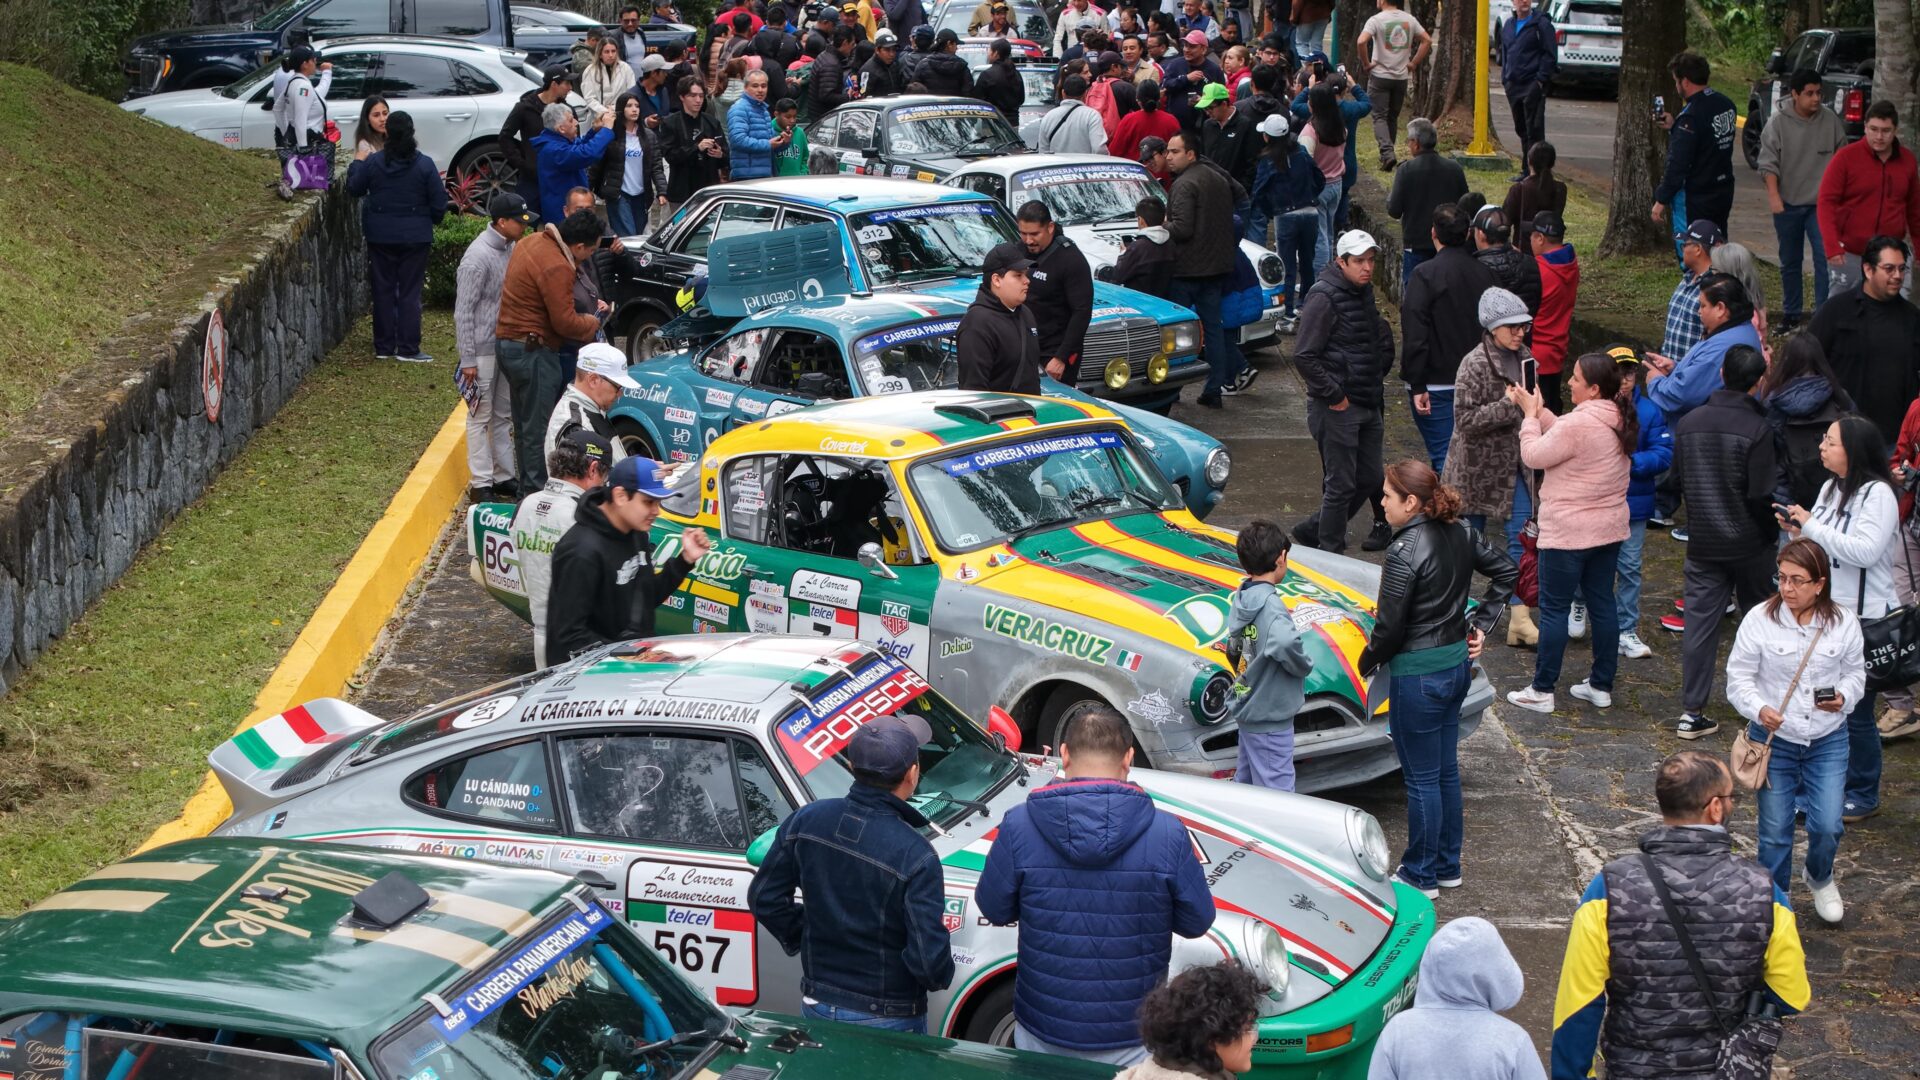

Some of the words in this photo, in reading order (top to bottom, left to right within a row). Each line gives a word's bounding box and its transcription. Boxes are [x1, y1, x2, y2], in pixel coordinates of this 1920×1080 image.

[1022, 174, 1085, 188] FARBEN
[1088, 171, 1149, 182] MOTORS
[892, 208, 927, 219] CARRERA
[927, 205, 980, 215] PANAMERICANA
[863, 228, 885, 240] 312
[883, 328, 925, 343] CARRERA
[878, 380, 904, 393] 299
[666, 408, 694, 420] PUEBLA
[974, 450, 1025, 467] CARRERA
[1025, 436, 1099, 457] PANAMERICANA
[819, 576, 849, 592] Carrera
[750, 599, 783, 614] VERACRUZ
[810, 605, 836, 620] telcel
[884, 602, 908, 618] TAG
[881, 615, 909, 638] HEUER
[984, 603, 1114, 665] VERACRUZ
[940, 637, 973, 658] Delicia
[1870, 643, 1896, 657] THE
[1865, 656, 1889, 669] OTE
[520, 705, 536, 723] LA
[540, 700, 602, 721] CARRERA
[789, 713, 812, 736] telcel
[811, 687, 851, 718] CARRERA
[802, 670, 929, 761] PORSCHE
[465, 779, 479, 792] LU
[480, 778, 530, 797] CÁNDANO
[463, 794, 473, 804] D.
[475, 795, 526, 811] CANDANO
[416, 841, 477, 859] MÉXICO
[485, 841, 545, 861] CHIAPAS
[1226, 850, 1246, 862] TO
[654, 865, 676, 881] La
[681, 868, 735, 888] Carrera
[668, 908, 713, 926] telcel
[655, 929, 731, 974] 567
[1364, 948, 1400, 988] DESIGNED
[1396, 937, 1409, 953] TO
[1406, 922, 1423, 940] WIN
[444, 1008, 467, 1030] telcel
[466, 967, 525, 1012] CARRERA
[514, 919, 590, 978] PANAMERICANA
